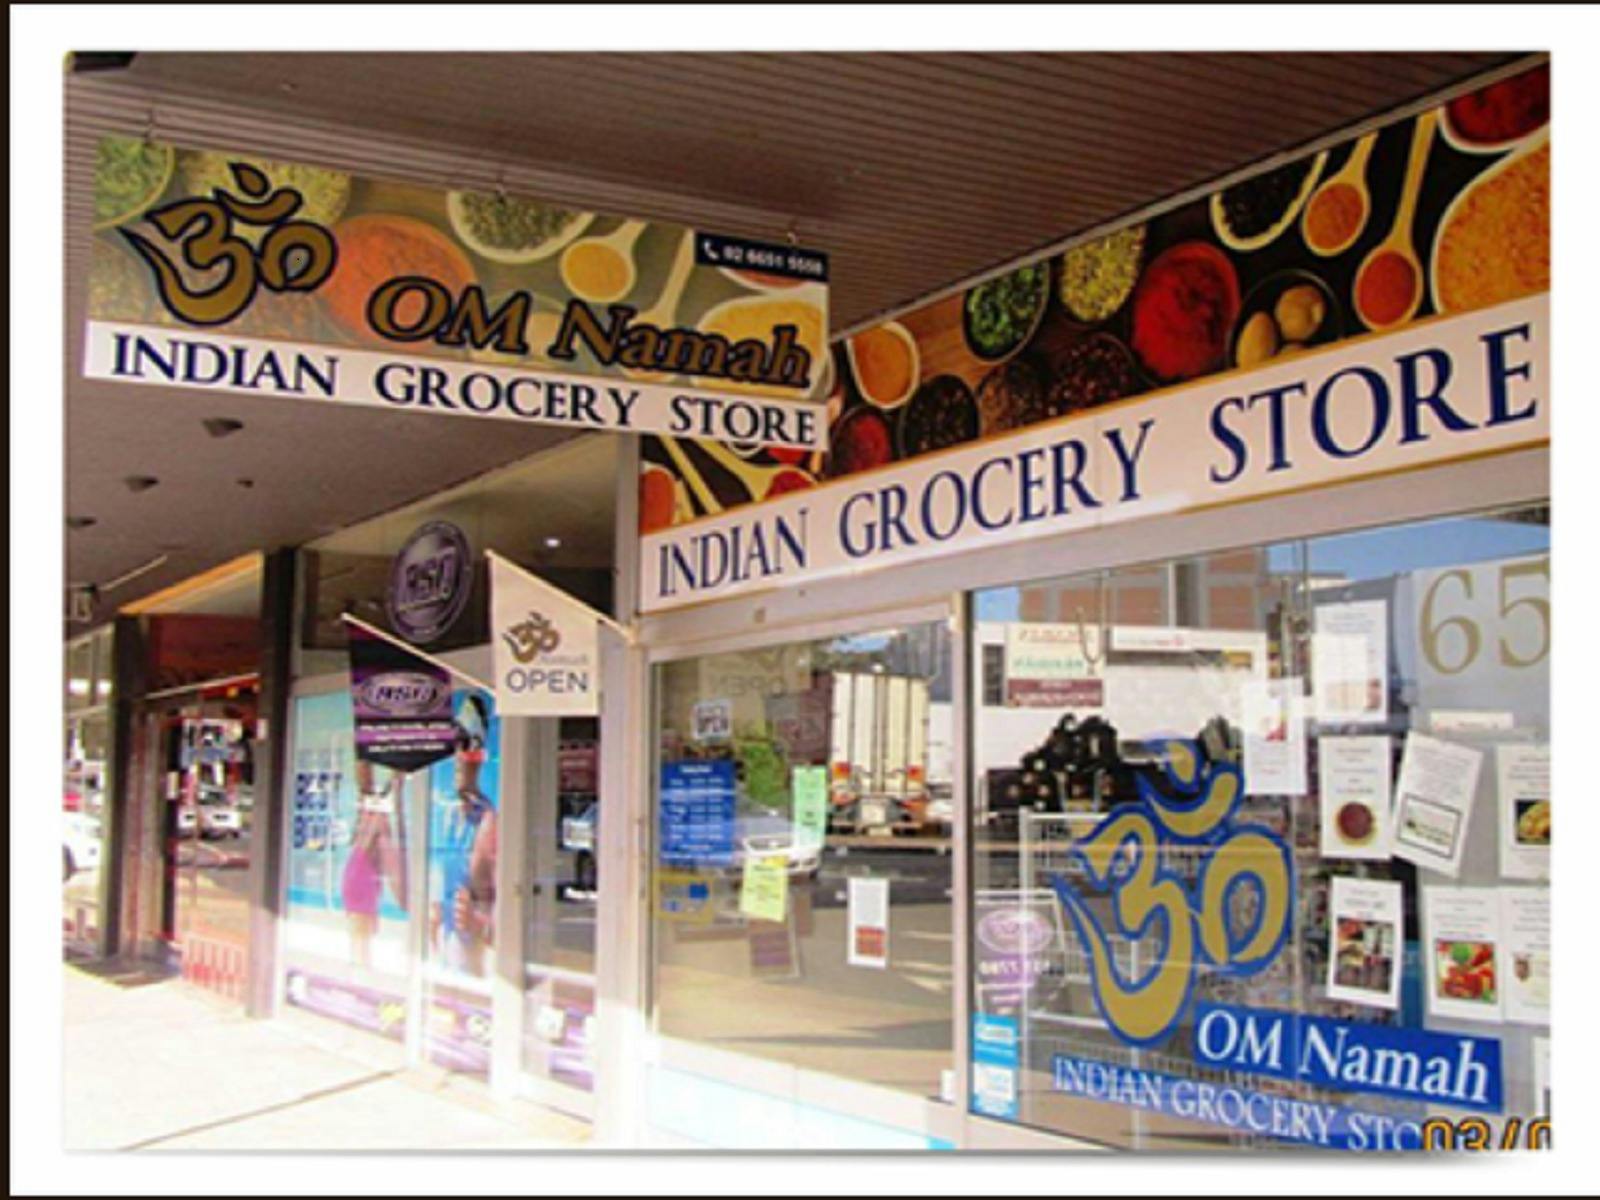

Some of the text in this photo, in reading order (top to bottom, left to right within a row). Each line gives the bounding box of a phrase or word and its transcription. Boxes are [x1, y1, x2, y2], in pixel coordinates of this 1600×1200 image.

[111, 332, 817, 447] INDIAN GROCERY STORE
[366, 276, 812, 391] OM Namah
[658, 323, 1538, 597] INDIAN GROCERY STORE
[1419, 563, 1551, 676] 65
[505, 668, 590, 694] OPEN
[1053, 1055, 1424, 1151] INDIAN GROCERY STO
[1198, 1009, 1490, 1103] OM Namah
